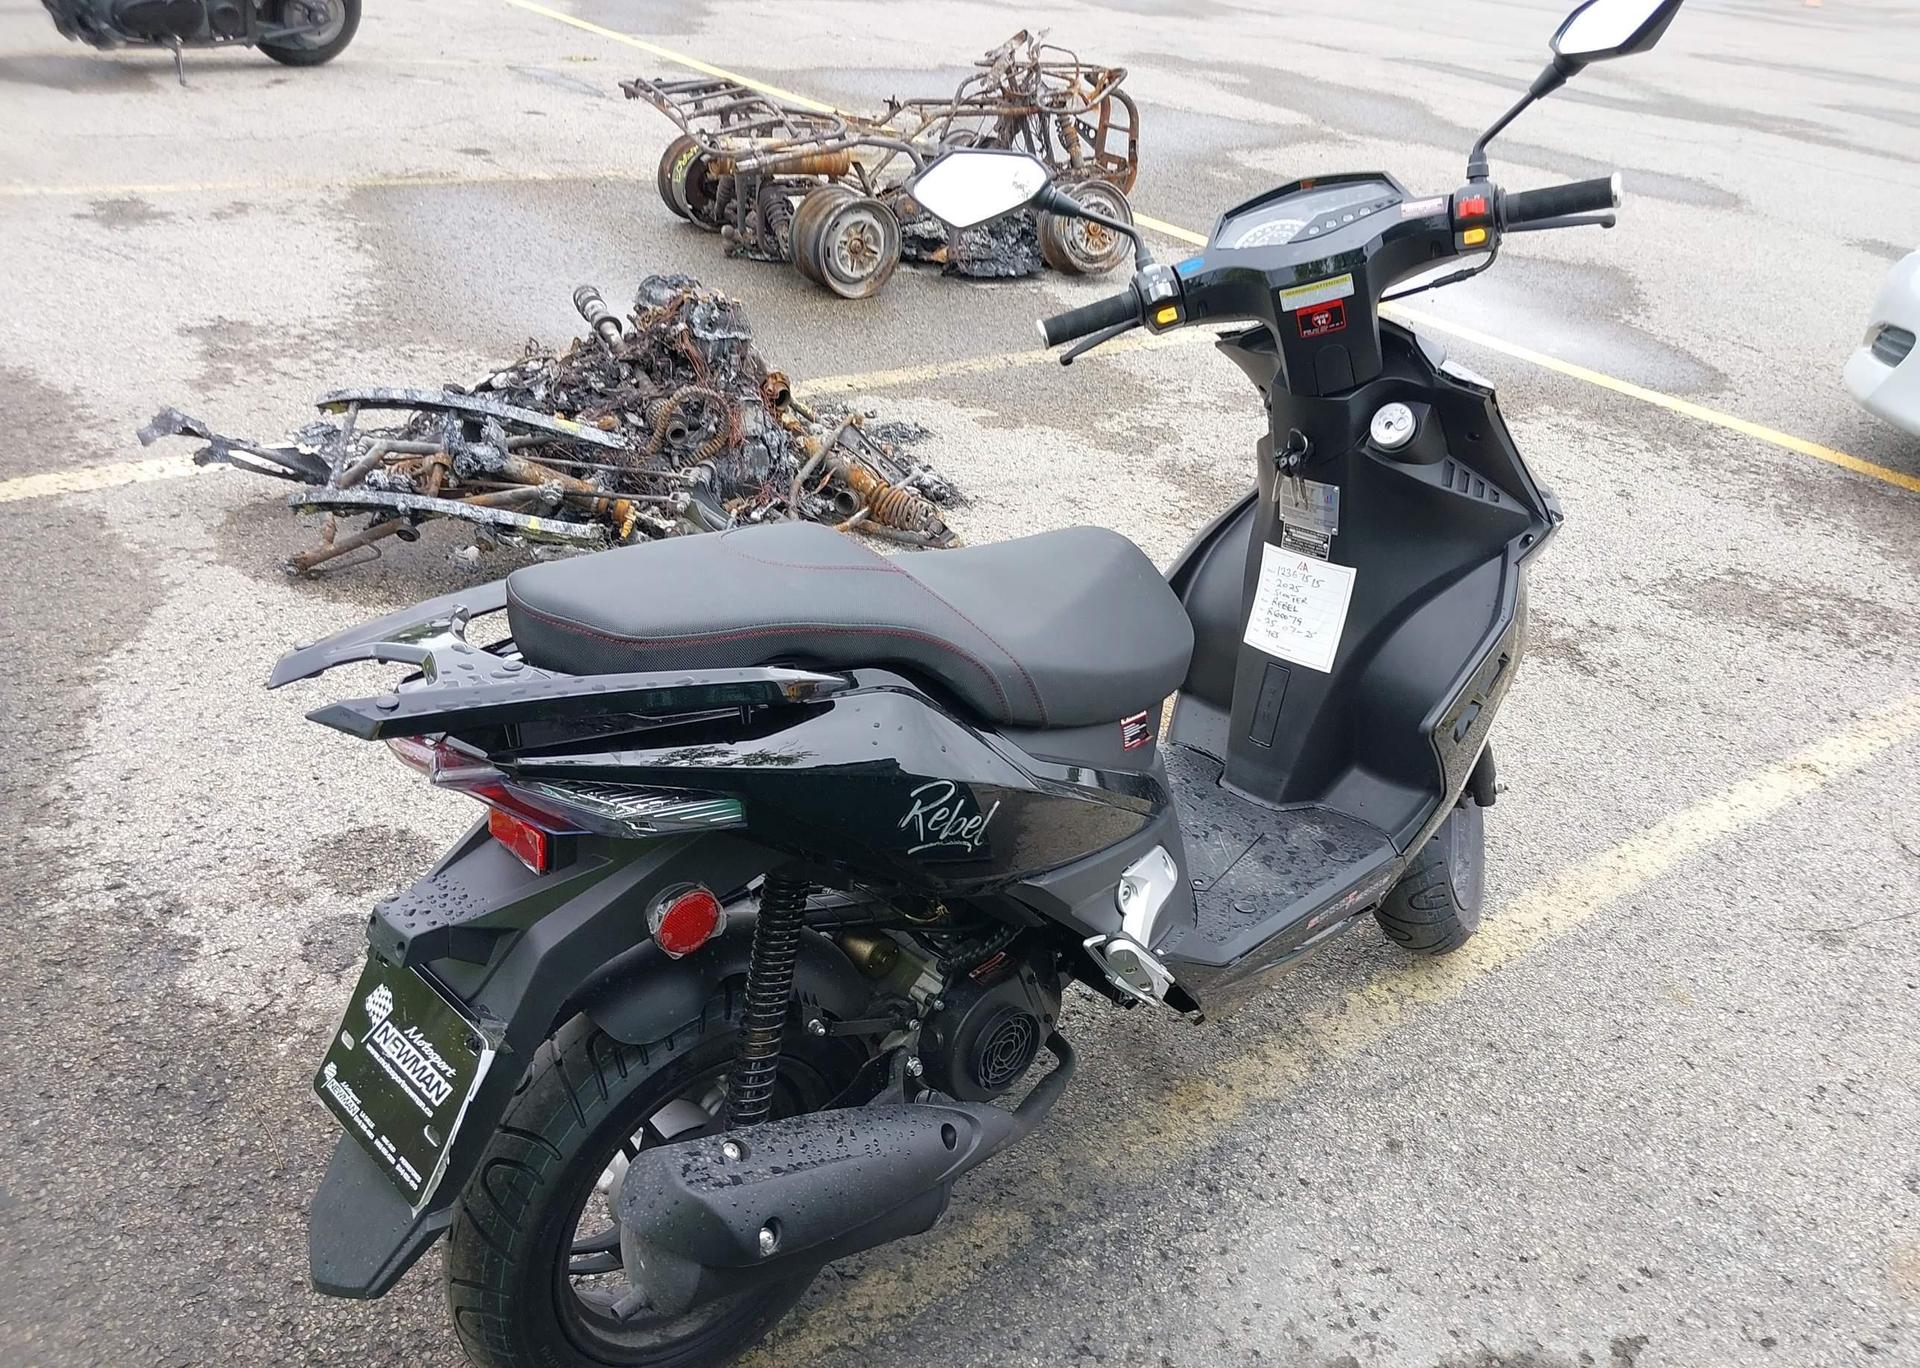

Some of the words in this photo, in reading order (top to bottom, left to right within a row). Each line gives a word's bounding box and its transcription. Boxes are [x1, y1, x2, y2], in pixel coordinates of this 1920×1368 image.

[1271, 597, 1298, 612] REBEL
[1275, 578, 1304, 593] 2025
[900, 780, 1000, 847] Rebel
[375, 1023, 452, 1105] NEWMAN
[404, 1026, 457, 1078] Motosport
[328, 1080, 359, 1116] NEWMAN
